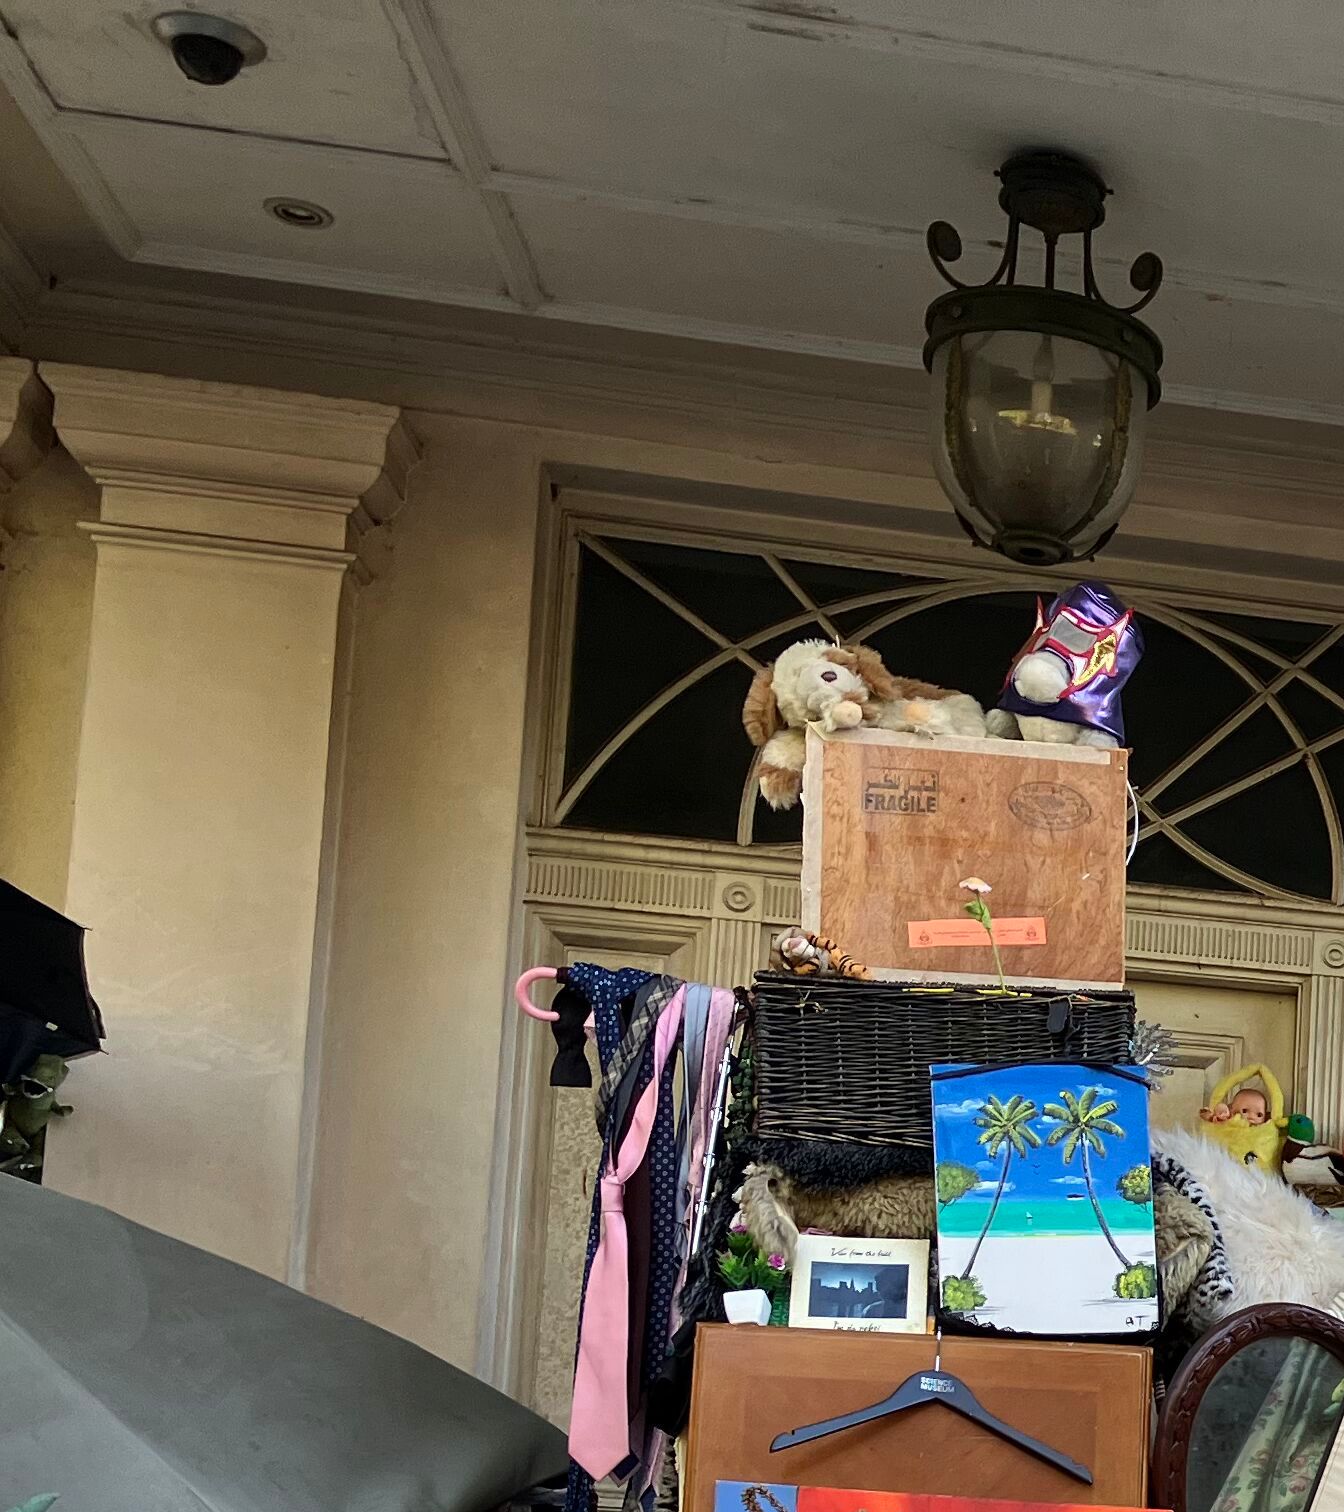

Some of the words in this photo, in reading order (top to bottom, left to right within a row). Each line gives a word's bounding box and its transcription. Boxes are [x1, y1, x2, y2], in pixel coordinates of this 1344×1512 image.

[864, 793, 937, 814] FRAGILE
[920, 1376, 953, 1386] SCIENCE
[920, 1384, 956, 1394] MUSEUM
